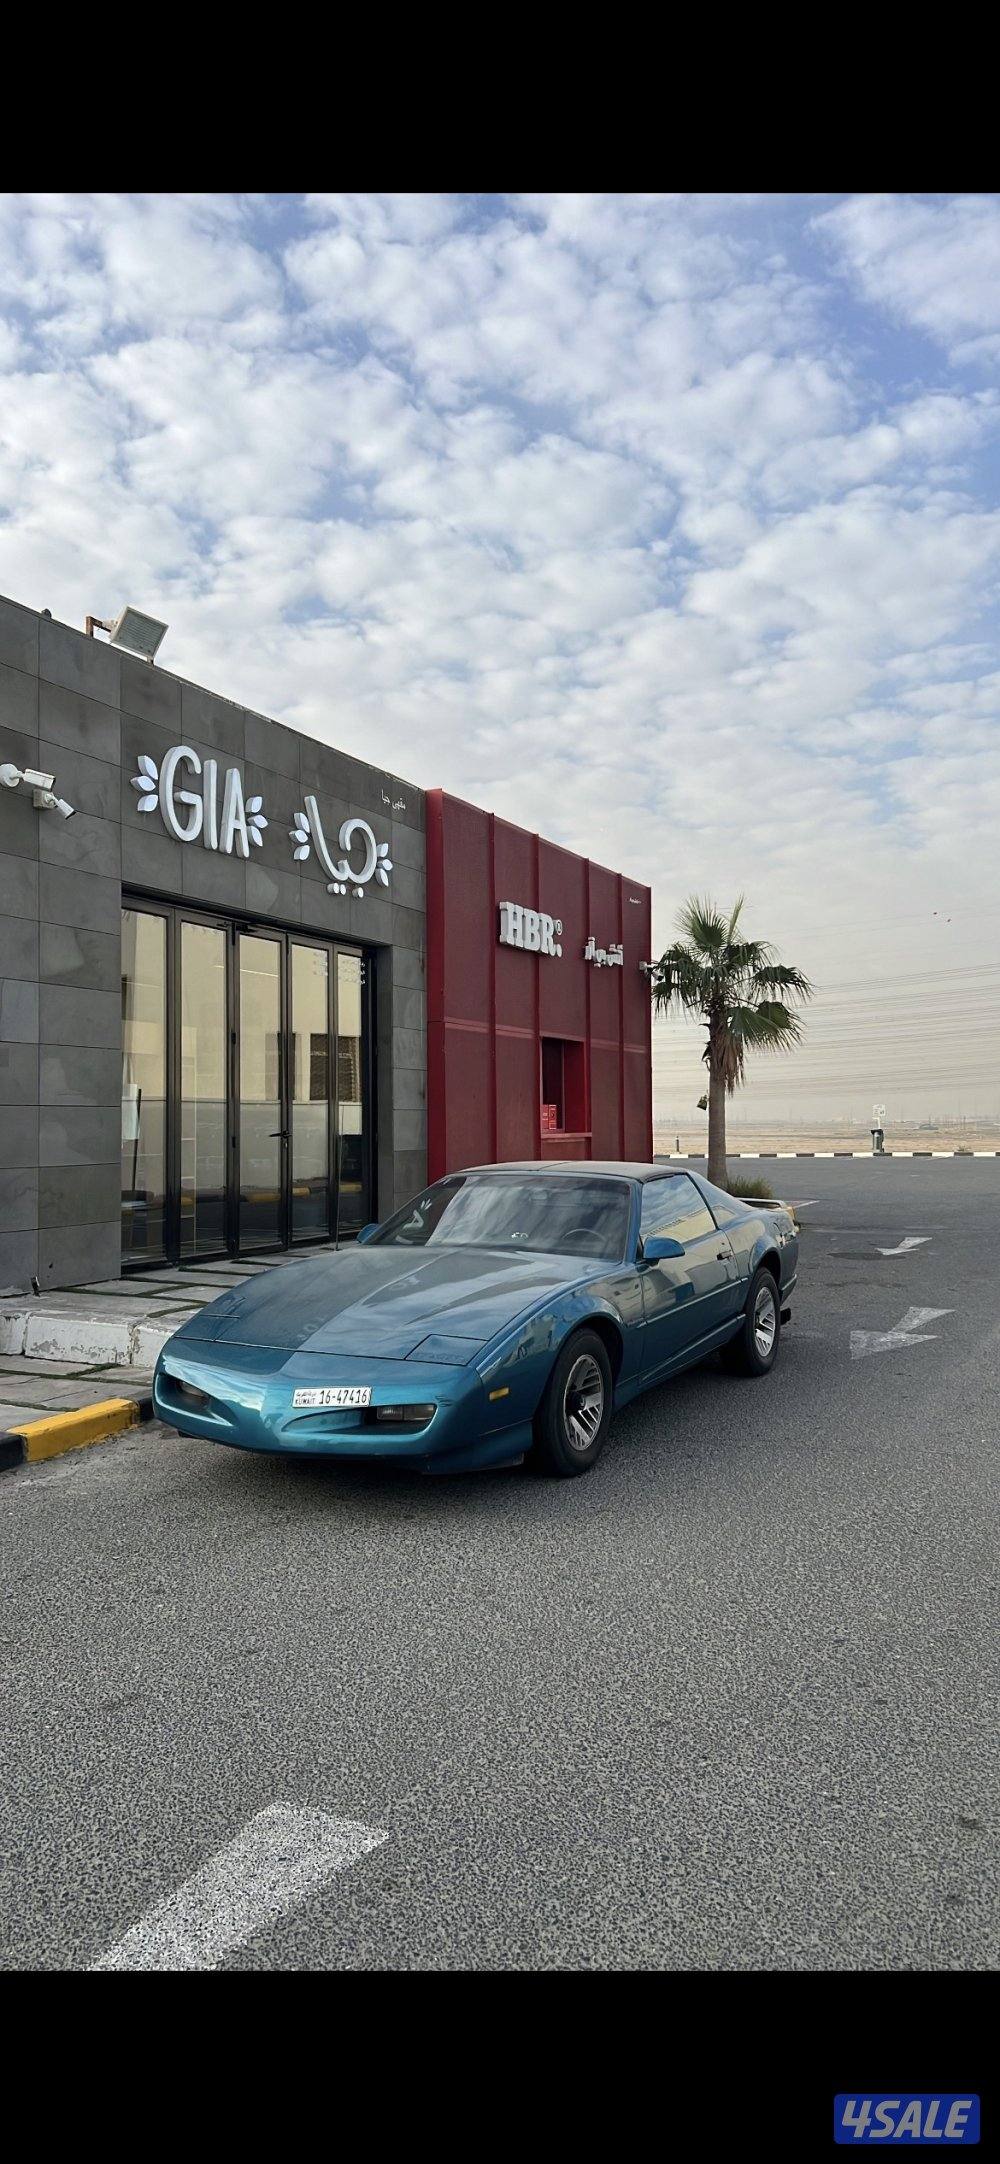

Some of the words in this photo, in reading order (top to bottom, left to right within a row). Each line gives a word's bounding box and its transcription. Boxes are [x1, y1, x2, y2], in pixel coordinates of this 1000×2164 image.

[159, 745, 249, 858] GIA
[304, 795, 378, 898] جيا
[319, 1389, 368, 1405] 16-47416
